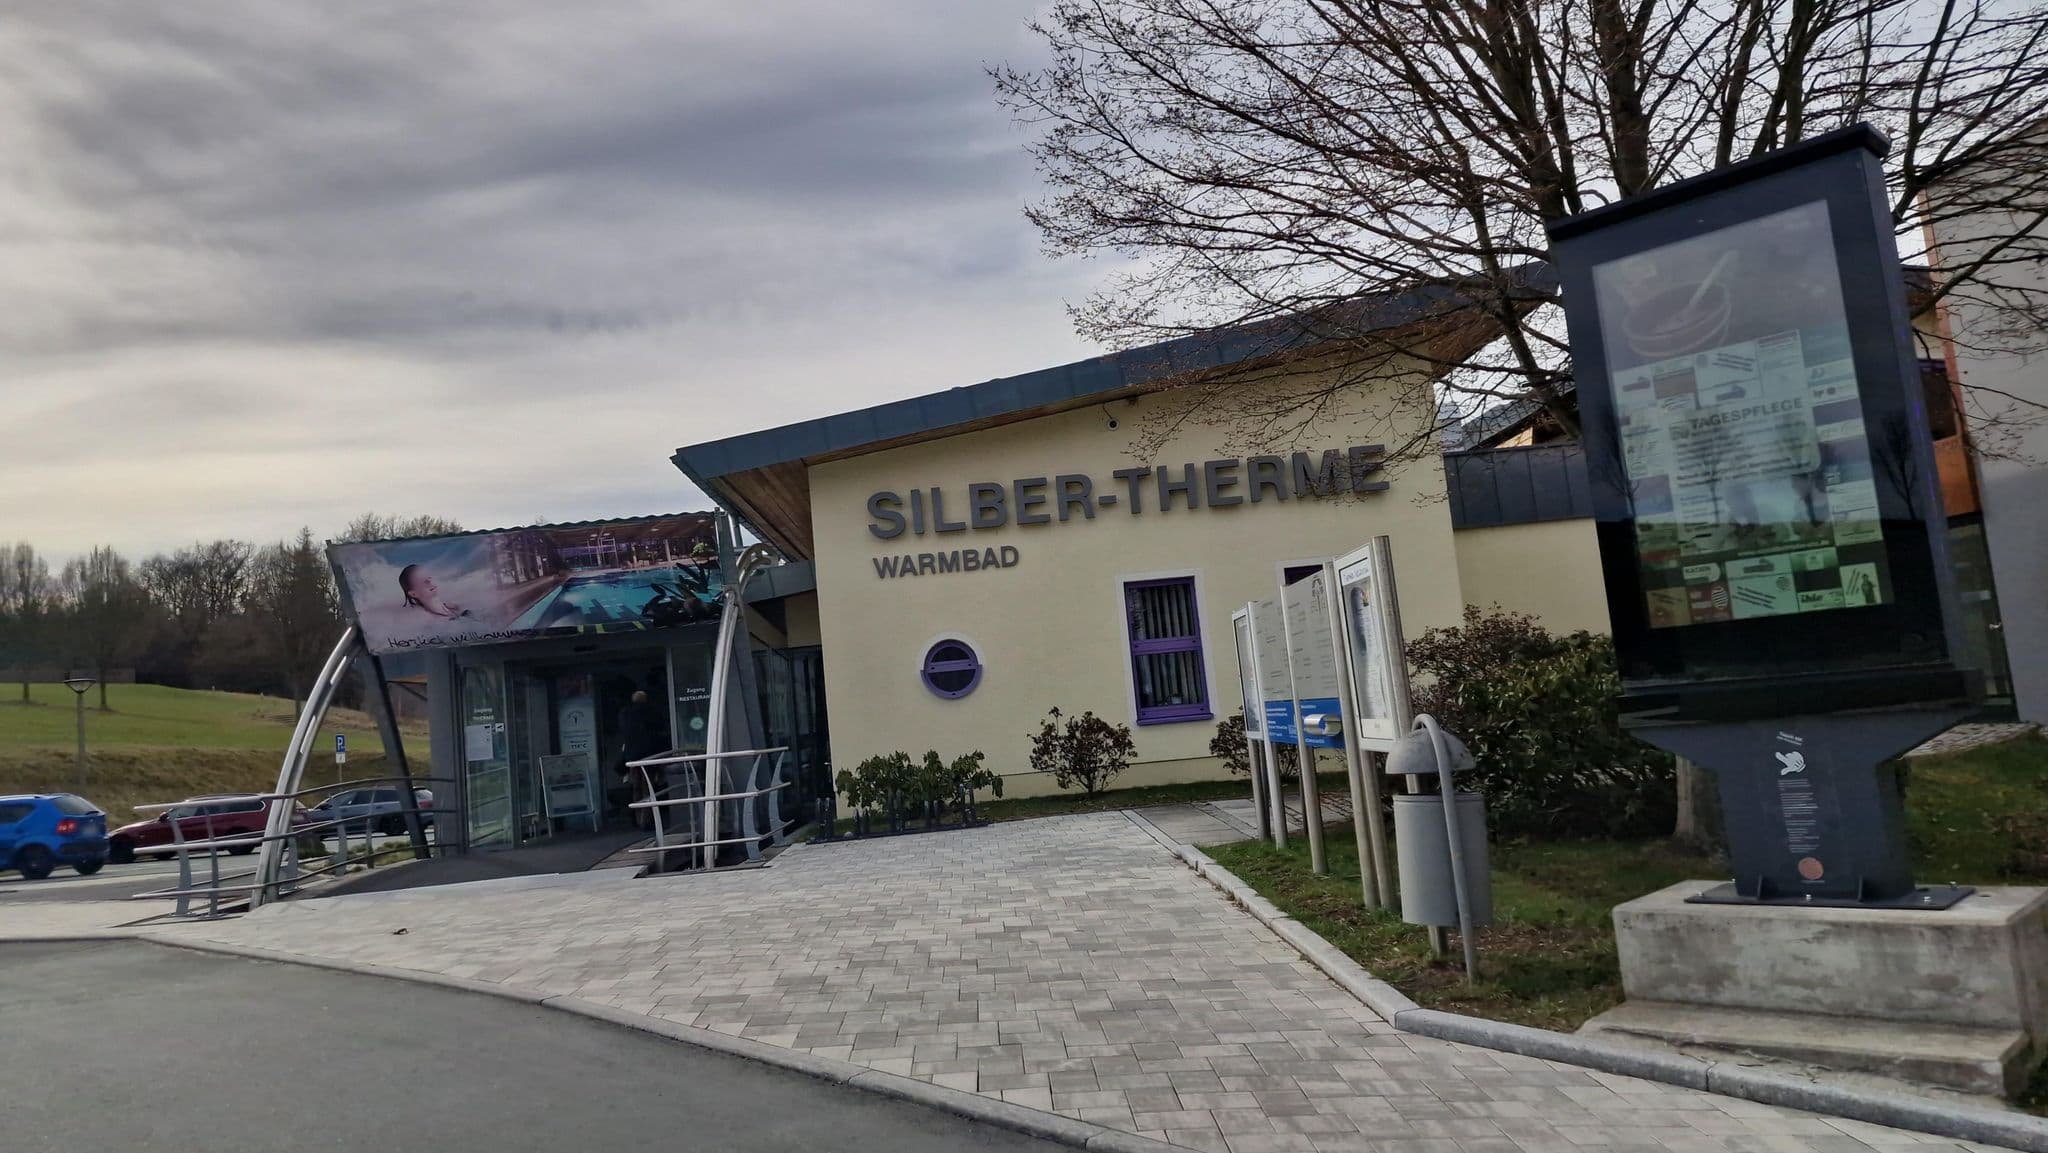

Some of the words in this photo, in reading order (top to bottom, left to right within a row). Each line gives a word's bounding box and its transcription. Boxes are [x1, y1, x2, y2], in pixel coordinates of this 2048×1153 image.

[1688, 398, 1803, 430] TAGESPFLEGE
[867, 443, 1391, 540] SILBER-THERME
[873, 545, 1020, 579] WARMBAD
[337, 736, 344, 751] P
